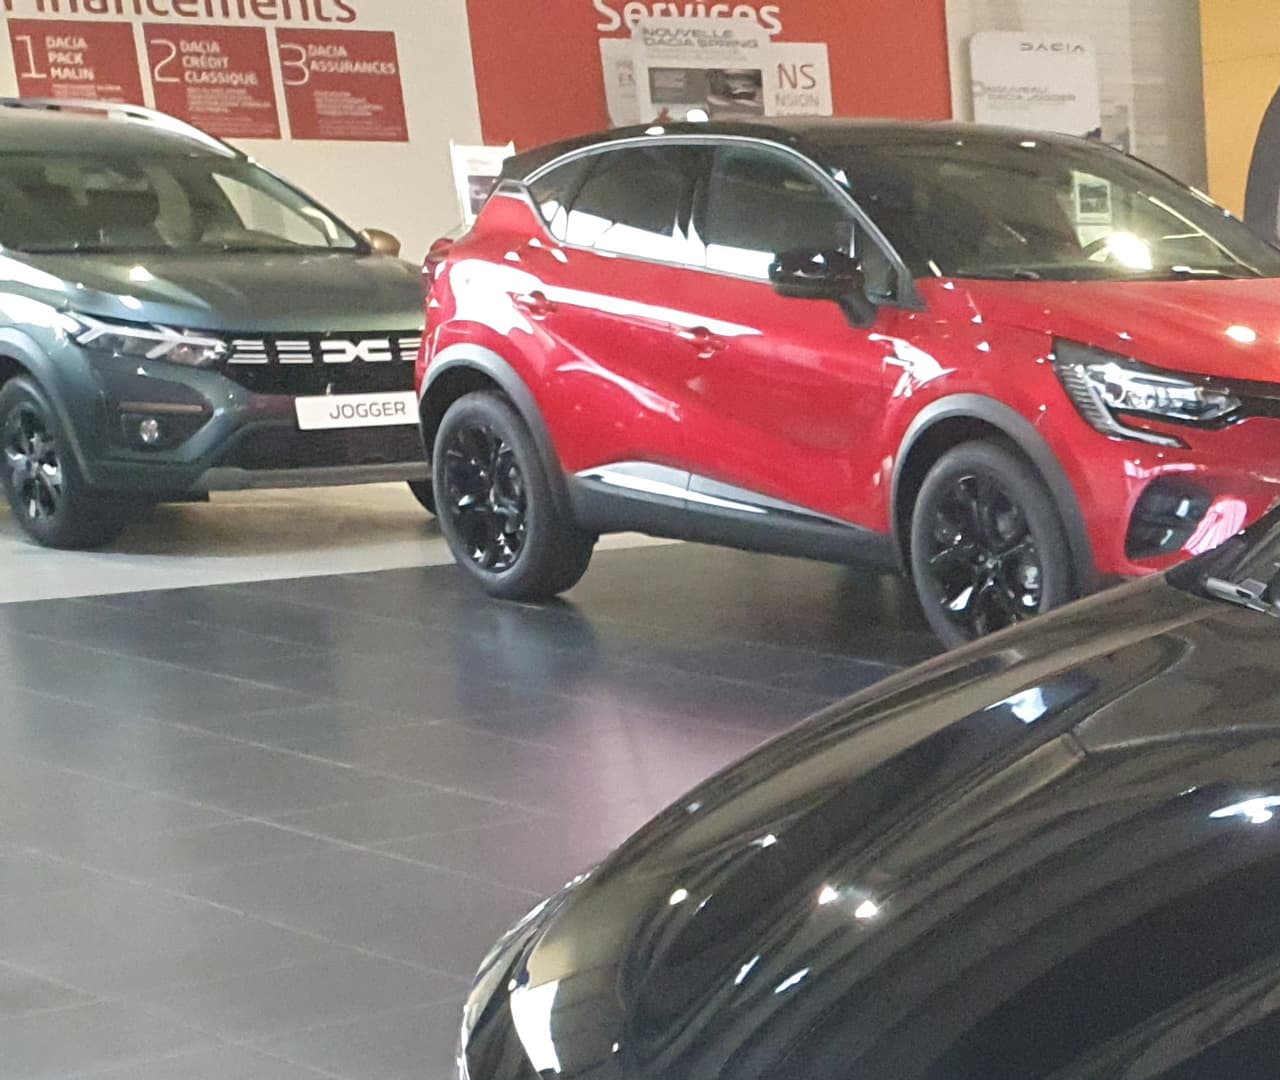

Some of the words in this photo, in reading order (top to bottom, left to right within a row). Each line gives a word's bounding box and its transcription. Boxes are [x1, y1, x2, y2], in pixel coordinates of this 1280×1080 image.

[643, 27, 735, 39] NOUVELLE
[45, 36, 88, 50] DACIA
[179, 40, 221, 54] DACIA
[644, 38, 692, 48] DACIA
[699, 39, 759, 49] SPRING
[1020, 42, 1085, 52] DACIA
[15, 35, 47, 79] 1
[48, 51, 84, 65] PACK
[308, 44, 348, 58] DACIA
[150, 39, 180, 82] 2
[280, 43, 310, 85] 3
[310, 60, 396, 75] ASSURANCES
[184, 70, 259, 86] CLASSIQUE
[329, 401, 406, 420] JOGGER
